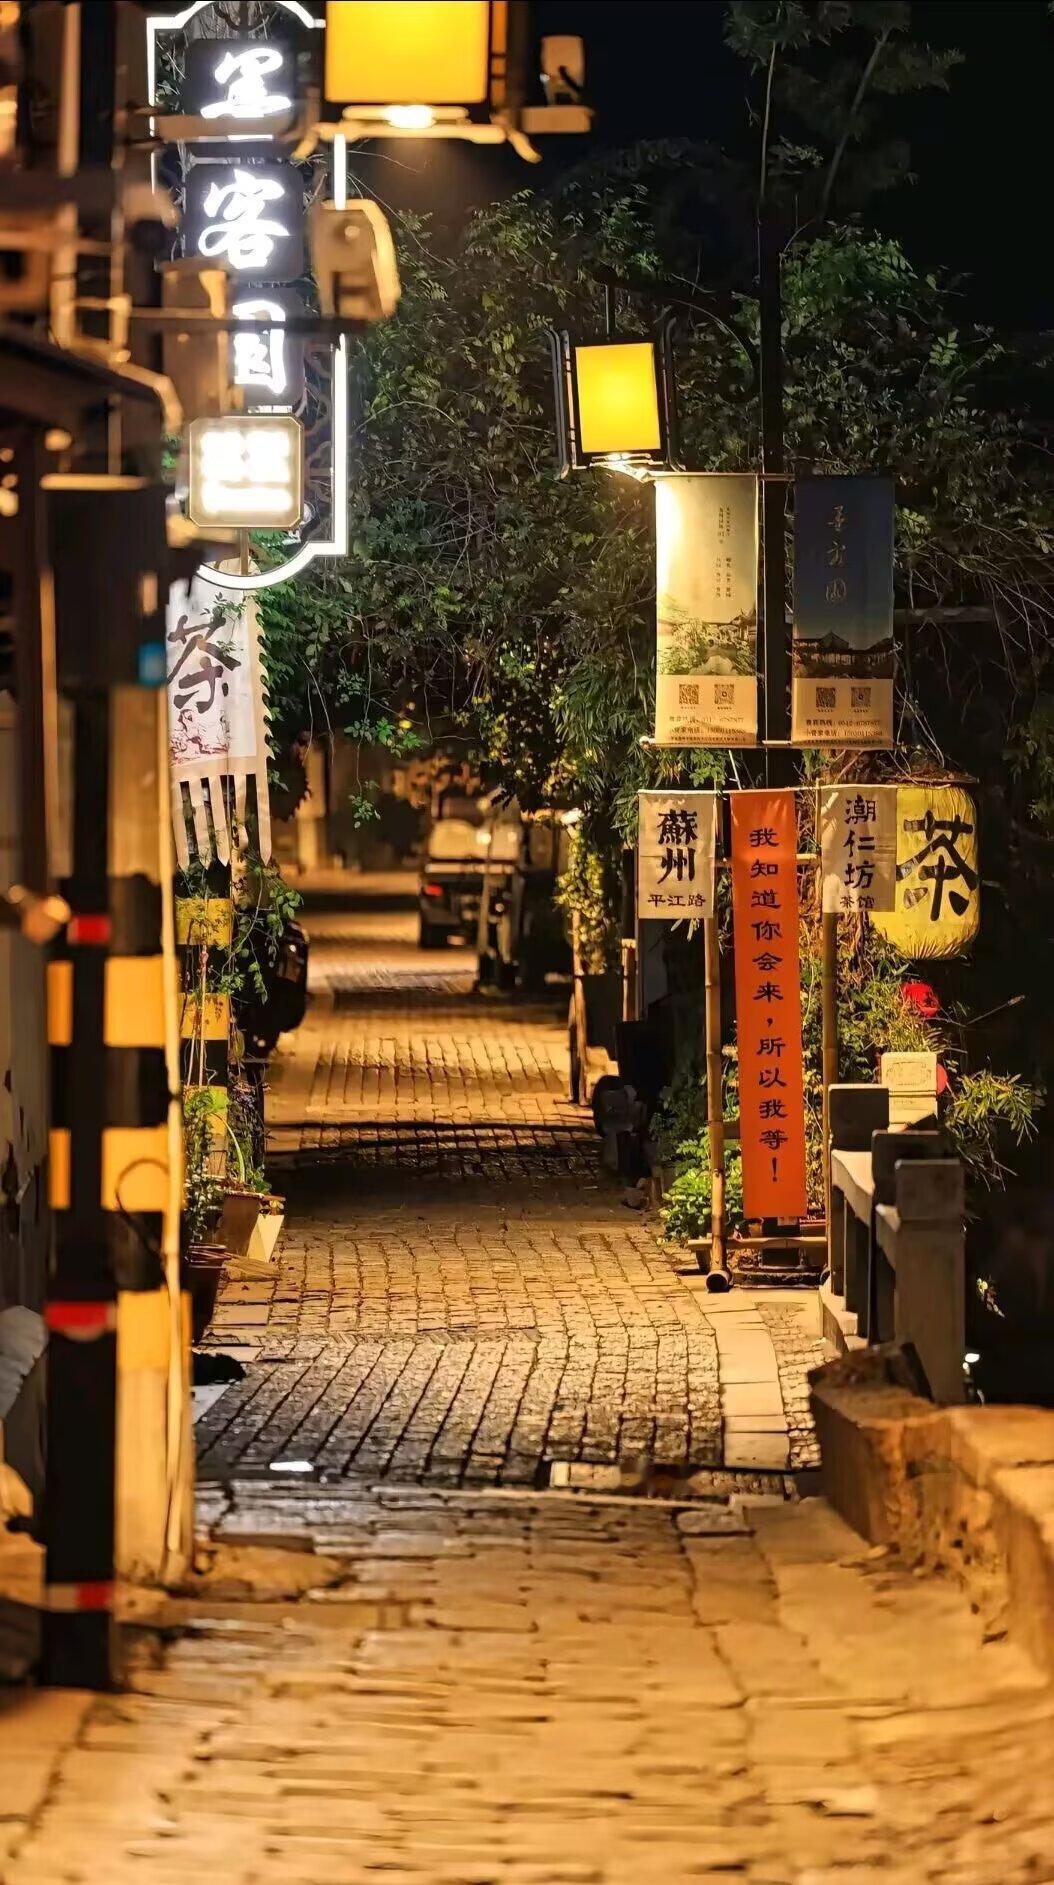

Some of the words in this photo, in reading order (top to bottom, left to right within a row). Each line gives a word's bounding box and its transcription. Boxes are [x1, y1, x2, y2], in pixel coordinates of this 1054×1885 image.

[167, 607, 242, 714] 茶
[656, 809, 698, 885] 蘇州
[843, 794, 877, 889] 潮仁坊
[896, 811, 977, 922] 茶
[647, 893, 706, 908] 平江路
[839, 895, 875, 910] 茶馆
